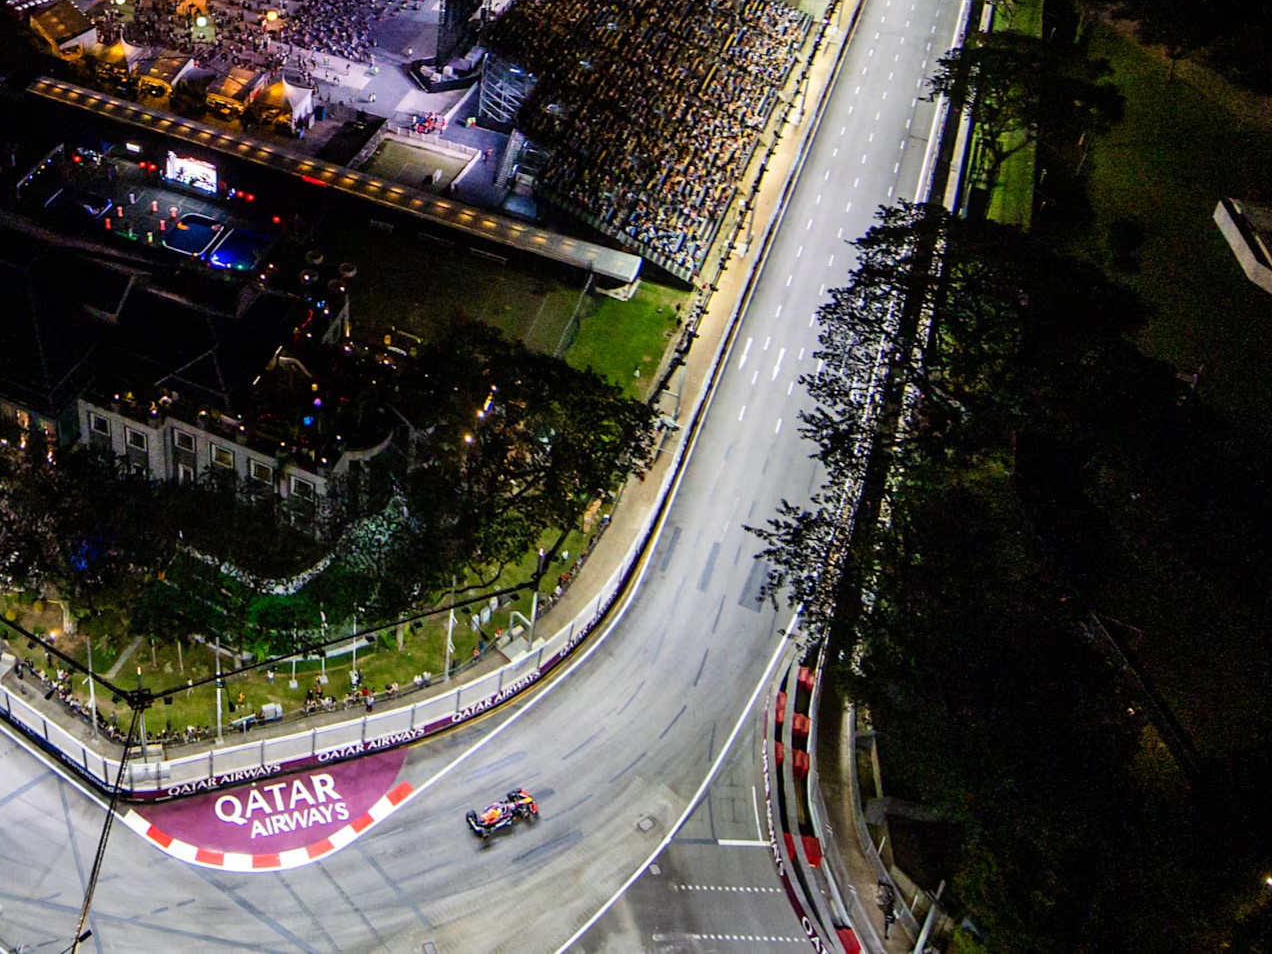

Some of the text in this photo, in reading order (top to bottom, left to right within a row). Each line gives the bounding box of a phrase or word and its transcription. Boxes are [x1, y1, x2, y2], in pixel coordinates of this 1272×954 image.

[451, 669, 541, 723] QATAR AIRWAYS
[317, 727, 425, 763] QATAR AIRWAYS
[167, 764, 282, 796] QATAR AIRWAYS
[215, 773, 343, 825] QATAR
[250, 802, 350, 839] AIRWAYS
